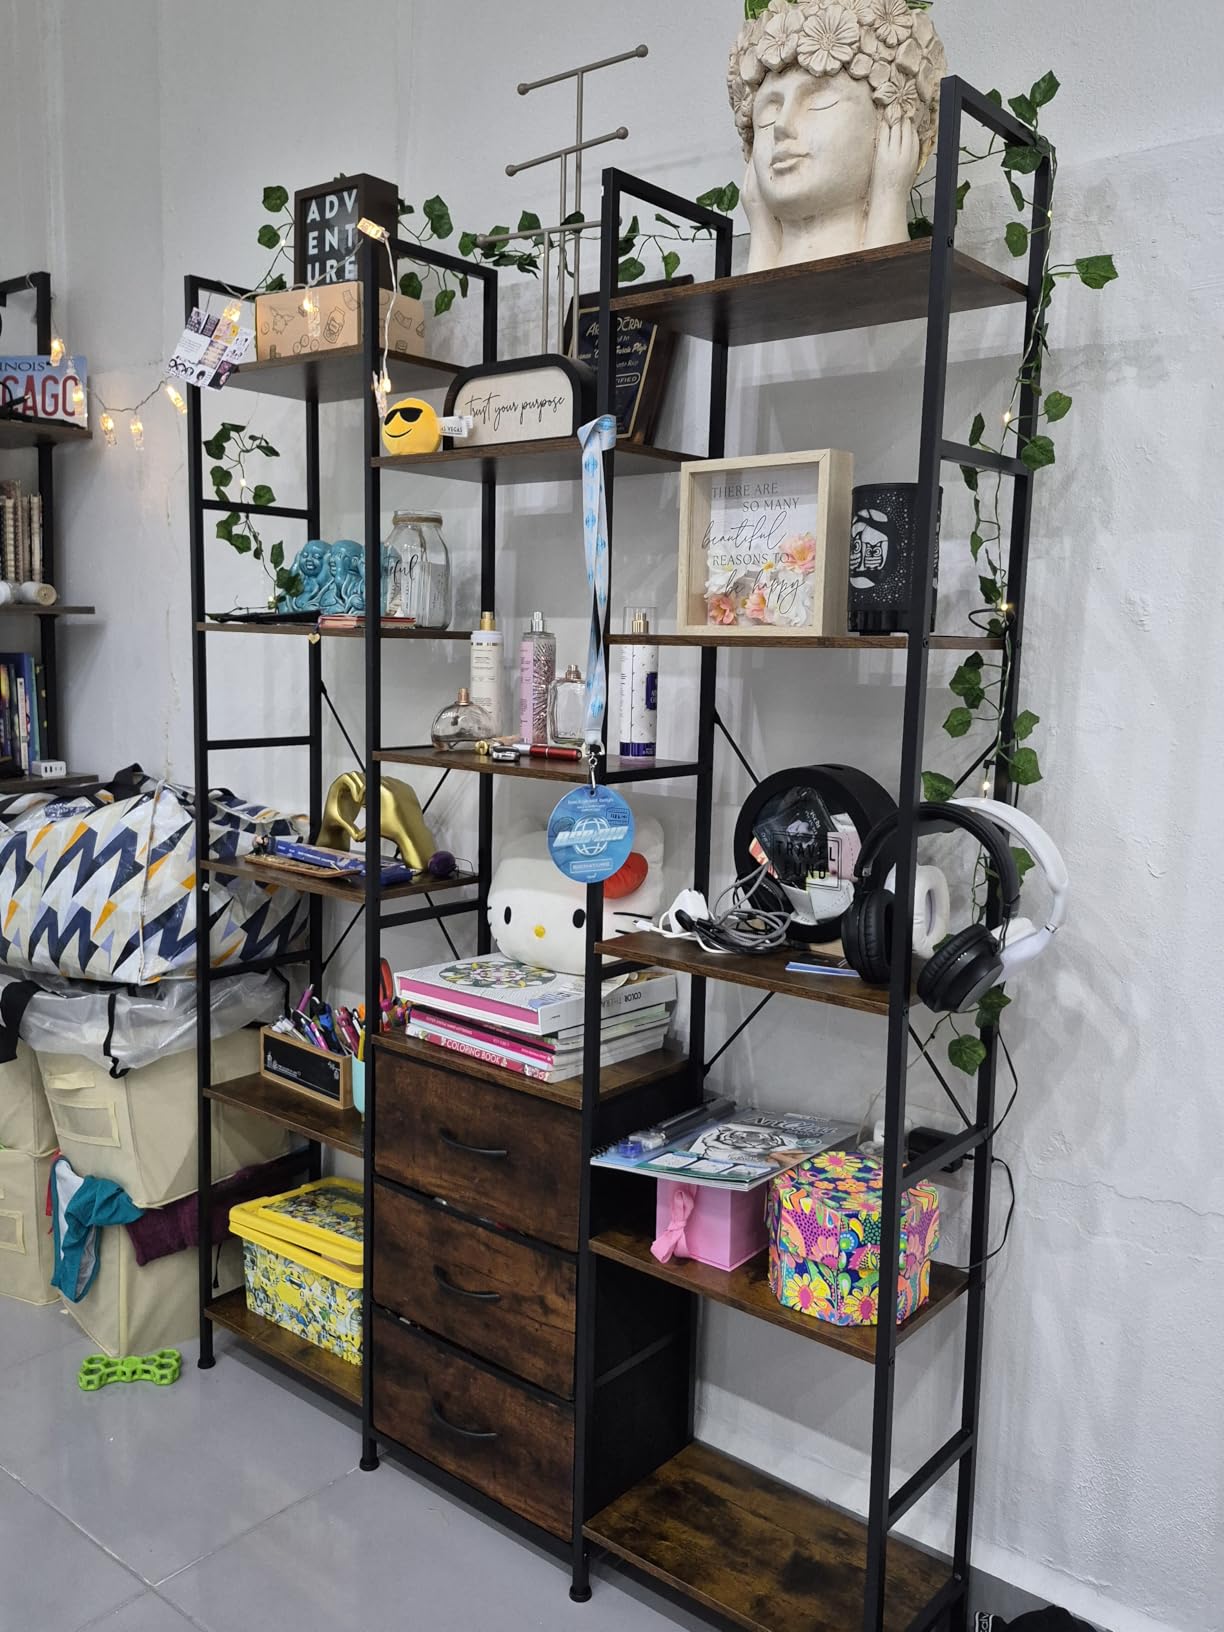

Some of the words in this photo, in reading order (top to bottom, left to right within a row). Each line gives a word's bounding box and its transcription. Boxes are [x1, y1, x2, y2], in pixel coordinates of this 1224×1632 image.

[307, 189, 357, 223] ADV
[308, 223, 356, 256] ENT
[307, 256, 358, 286] URE
[0, 361, 45, 372] INOIS
[1, 374, 79, 417] CAGO
[465, 392, 500, 425] trust
[494, 401, 518, 432] your
[518, 396, 565, 425] purpose
[712, 484, 750, 499] THERE
[754, 482, 778, 496] ARE
[742, 500, 760, 513] SO
[764, 497, 800, 511] MANY
[701, 511, 788, 551] beautiful
[712, 553, 768, 567] REASONS
[773, 552, 790, 564] TO
[724, 569, 745, 597] be
[752, 568, 806, 615] happy
[624, 991, 642, 1002] COLOR
[446, 1039, 481, 1058] COLORING
[481, 1051, 501, 1065] BOOK
